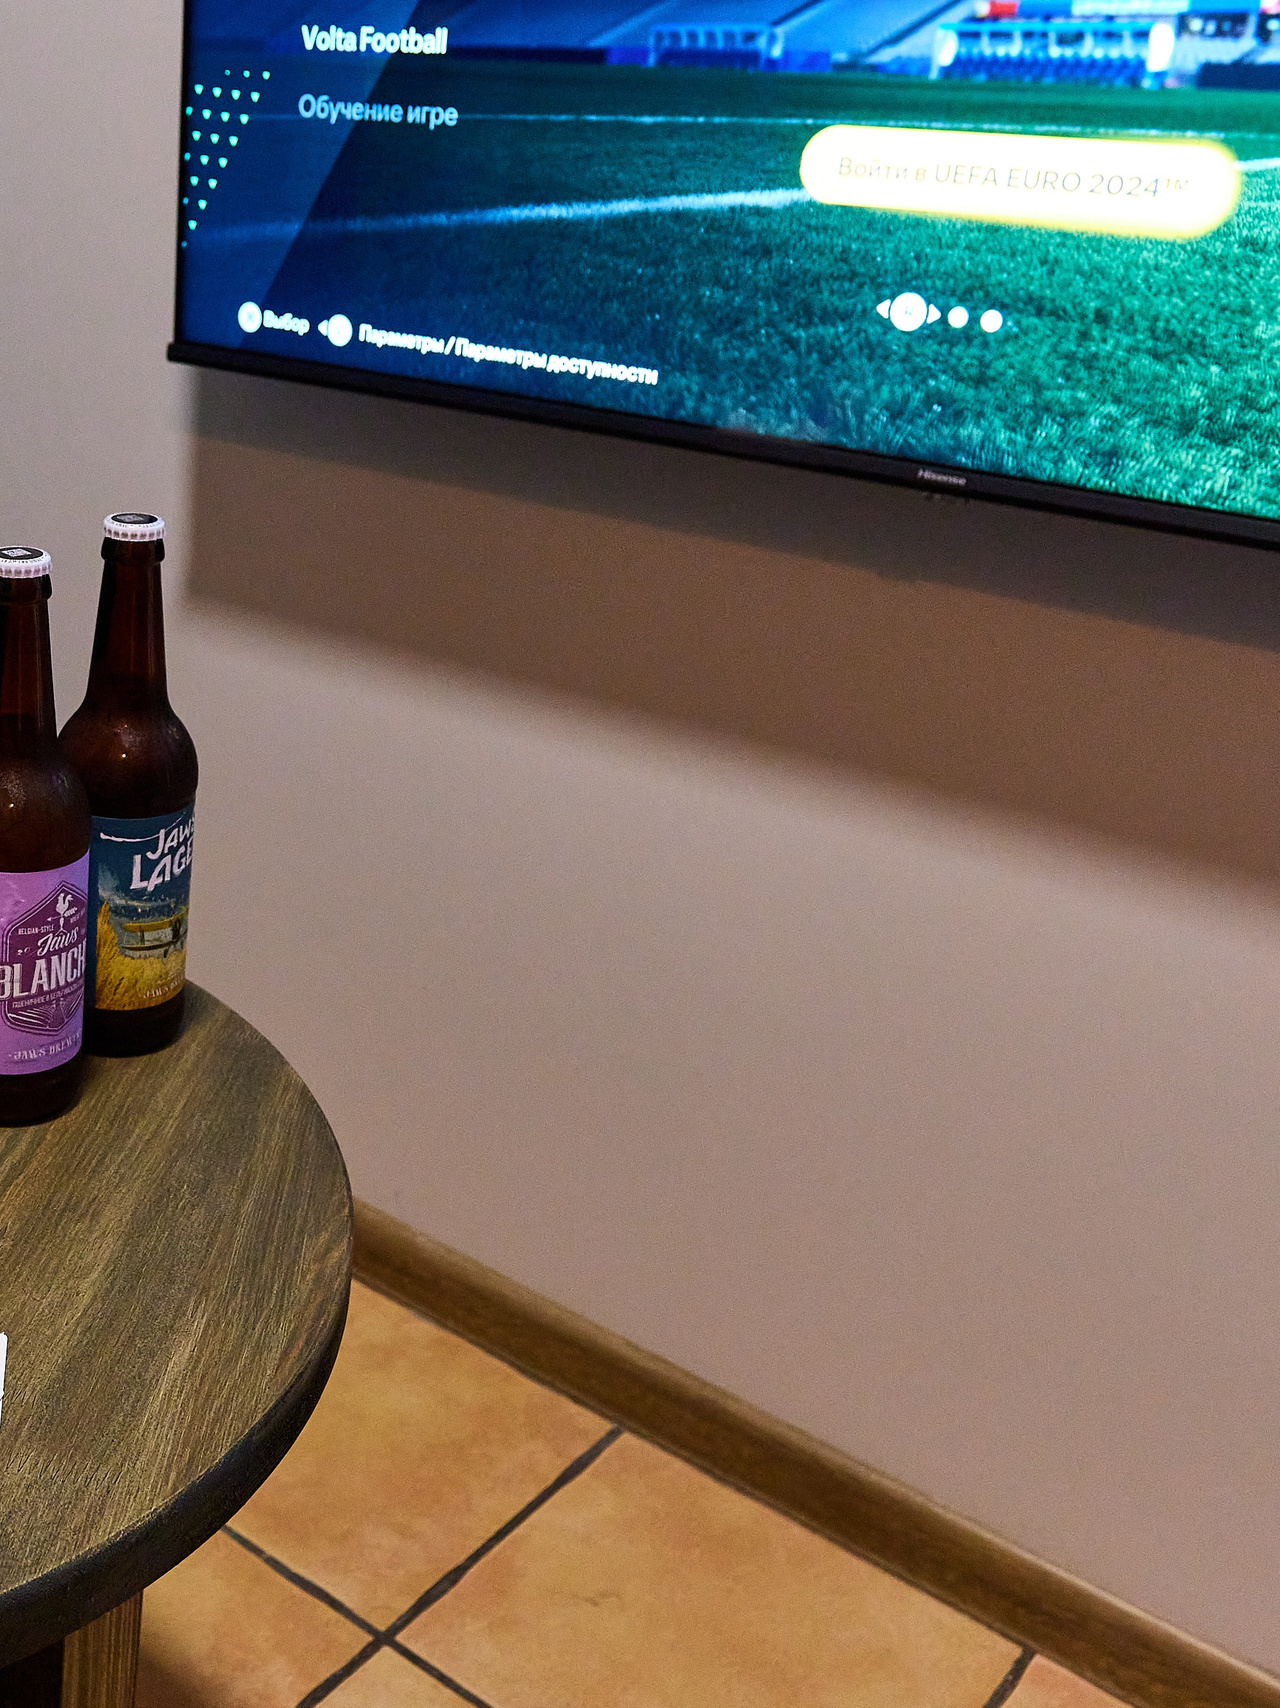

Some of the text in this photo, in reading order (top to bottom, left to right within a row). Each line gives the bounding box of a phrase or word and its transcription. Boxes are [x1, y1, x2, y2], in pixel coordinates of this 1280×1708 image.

[301, 25, 448, 54] Volta Football
[298, 93, 459, 130] Обучение игре
[839, 156, 907, 178] Войти
[915, 168, 926, 181] в
[935, 164, 997, 186] UEFA
[1007, 168, 1081, 192] EURO
[263, 309, 310, 336] Выбор
[358, 323, 444, 354] Параметры
[455, 337, 547, 369] Параметры
[547, 354, 659, 386] доступности
[130, 836, 193, 892] LAGE
